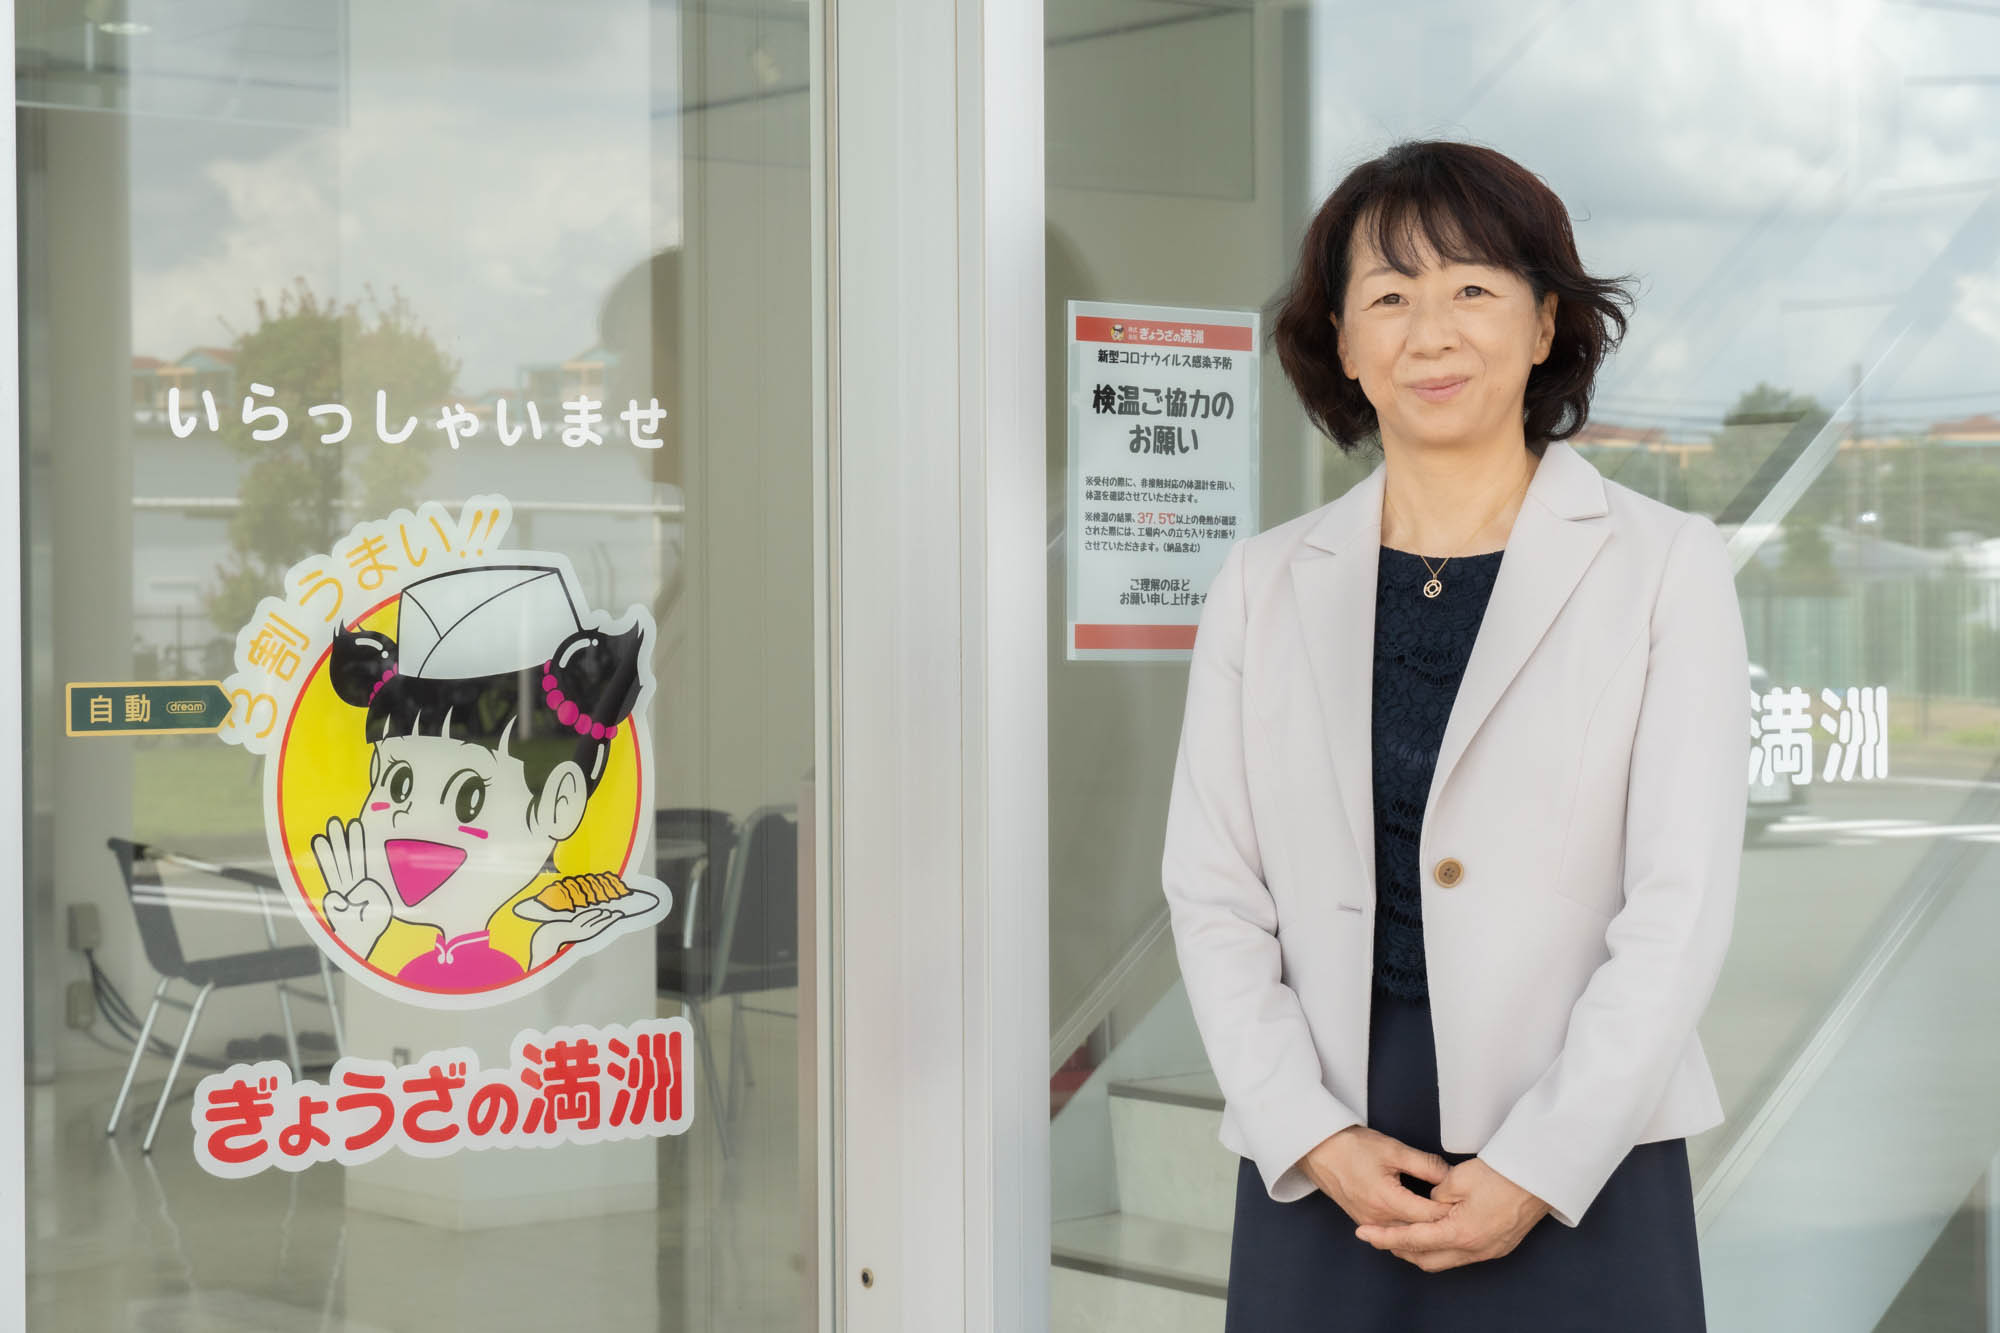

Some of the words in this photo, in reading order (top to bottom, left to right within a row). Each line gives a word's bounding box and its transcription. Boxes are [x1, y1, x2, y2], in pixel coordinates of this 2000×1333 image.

[1139, 327, 1205, 344] ぎょうざの満洲
[1098, 349, 1232, 370] 新型コロナウイルス感染予防
[1093, 384, 1234, 419] 検温ご協力の
[169, 383, 667, 449] いらっしゃいませ
[1129, 424, 1198, 455] お願い
[1085, 490, 1198, 503] 体温を確認させていただきます。
[1130, 578, 1190, 592] ご理解のほど
[169, 702, 203, 712] dream
[1748, 686, 1888, 786] 満洲
[205, 1031, 683, 1163] ぎょうざの満洲
